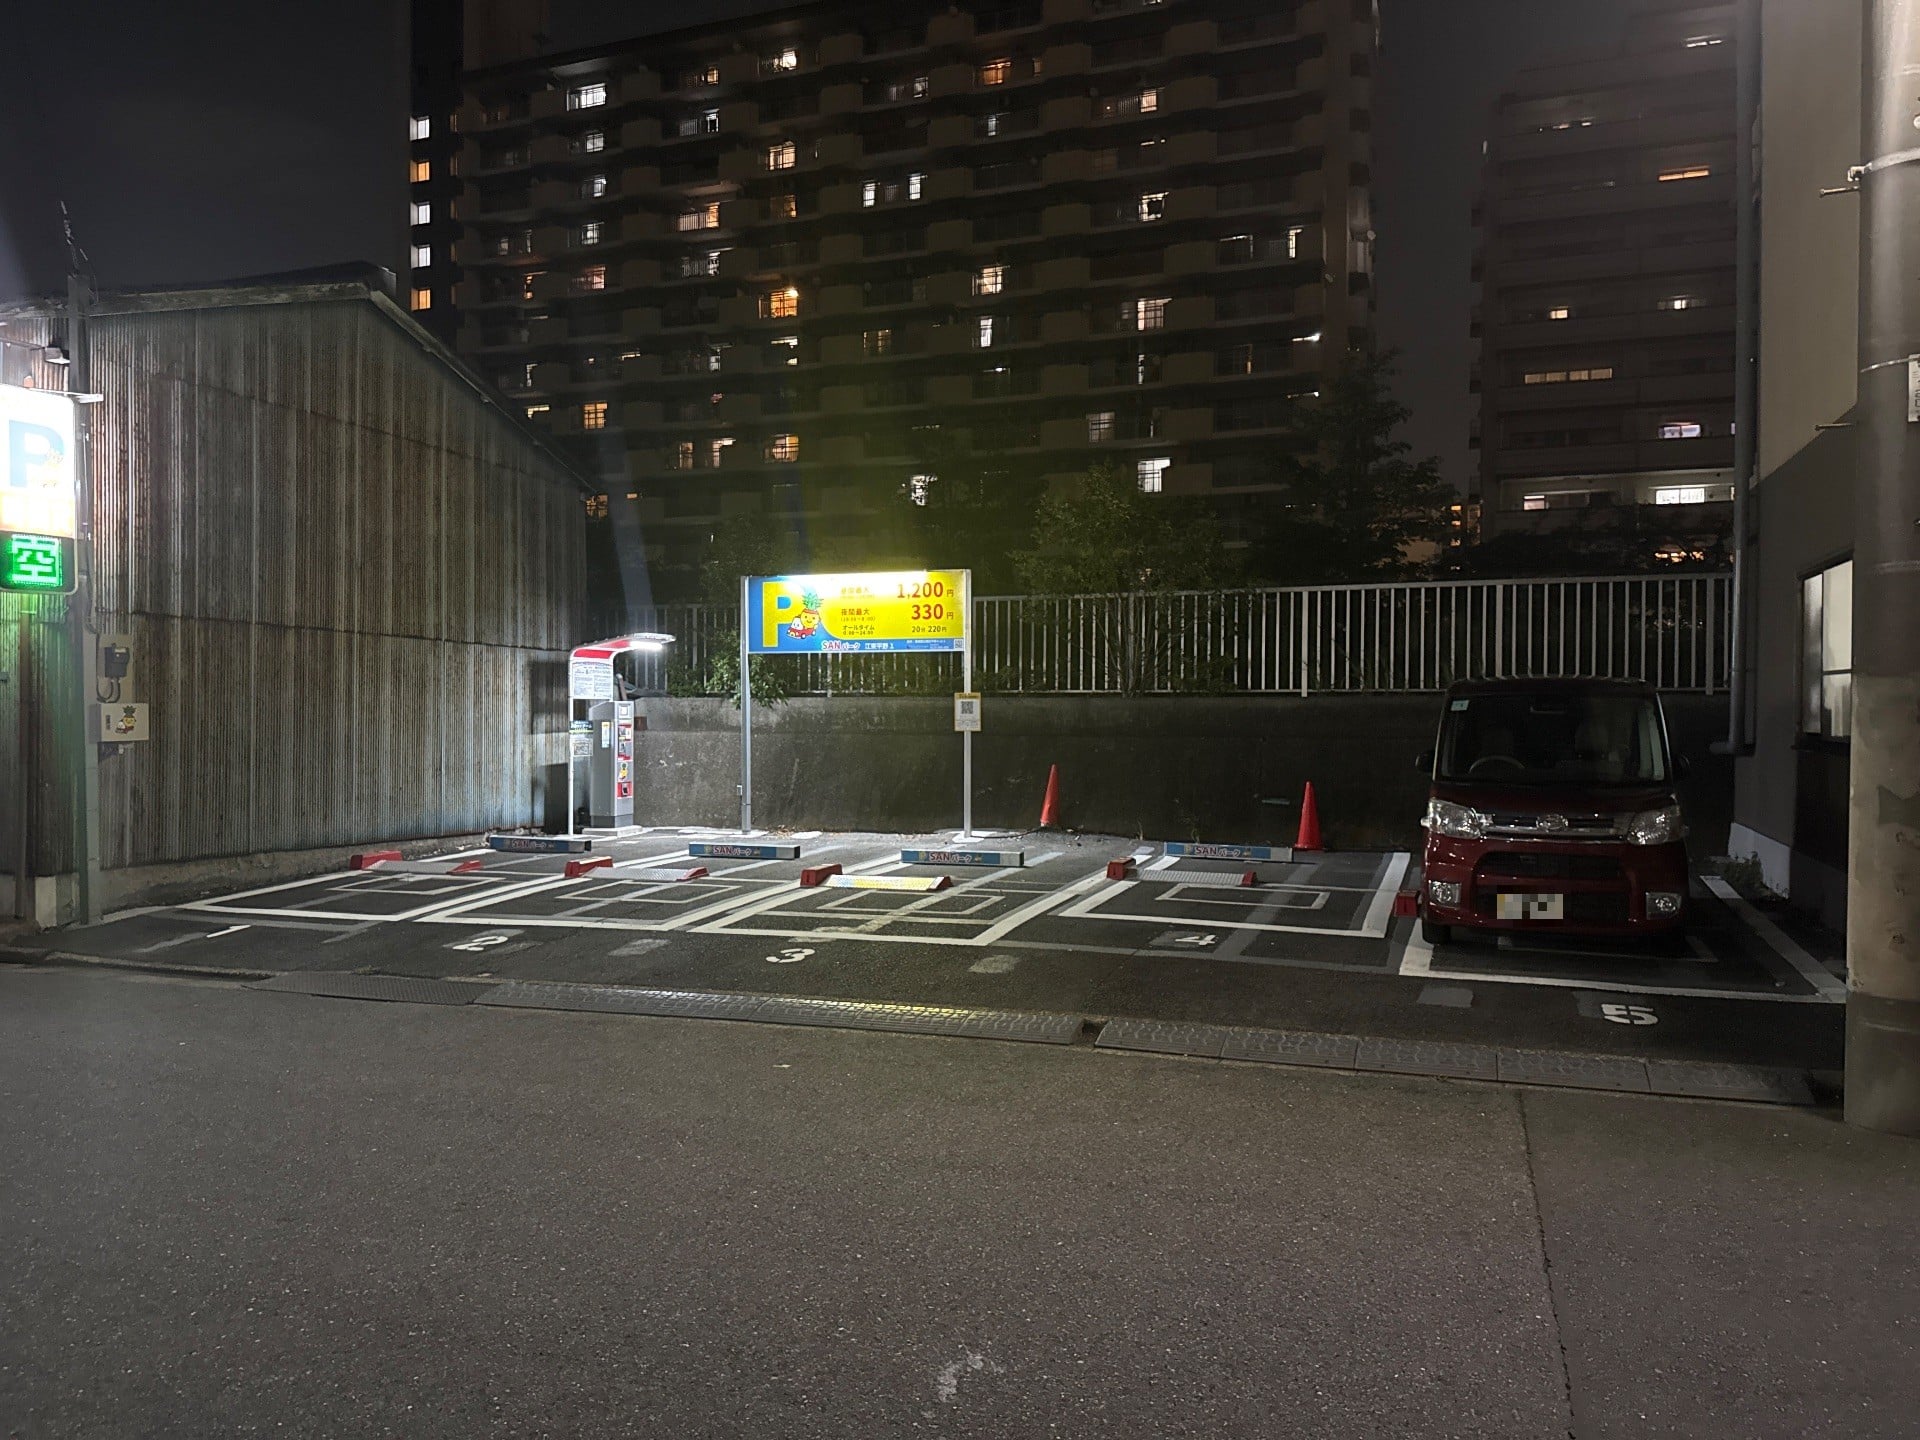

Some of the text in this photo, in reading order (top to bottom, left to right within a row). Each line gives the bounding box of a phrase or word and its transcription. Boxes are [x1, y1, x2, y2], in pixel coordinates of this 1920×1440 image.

[8, 419, 65, 488] P
[11, 535, 60, 585] 空
[762, 581, 799, 648] P
[452, 935, 508, 951] 2
[1175, 935, 1216, 946] 4
[766, 948, 815, 963] 3
[1601, 1004, 1658, 1025] 5
